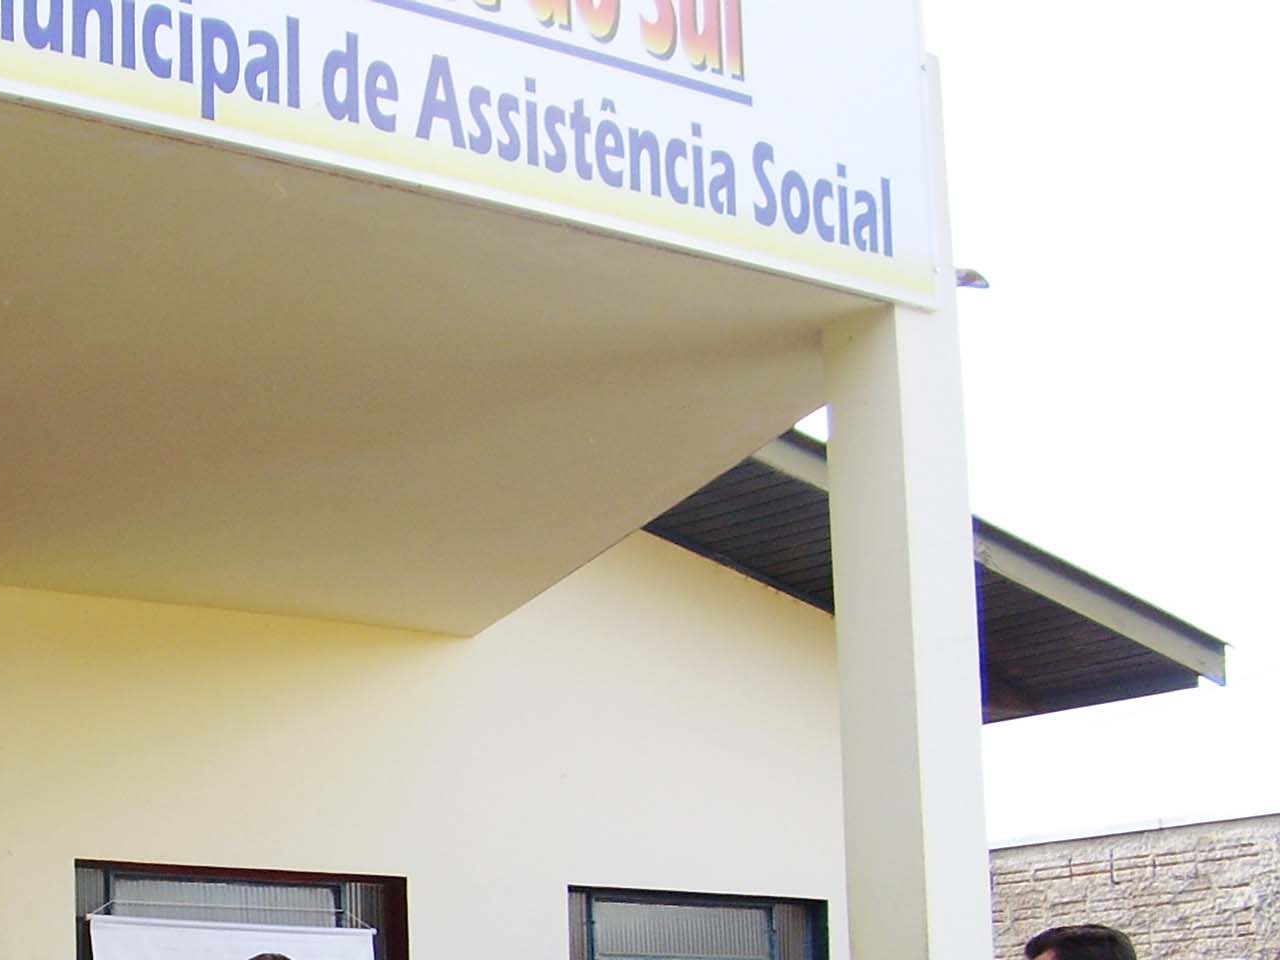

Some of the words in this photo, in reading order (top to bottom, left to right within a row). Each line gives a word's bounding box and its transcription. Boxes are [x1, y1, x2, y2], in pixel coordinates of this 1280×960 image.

[322, 32, 400, 133] de
[415, 54, 737, 216] Assistência
[752, 141, 894, 257] Social
